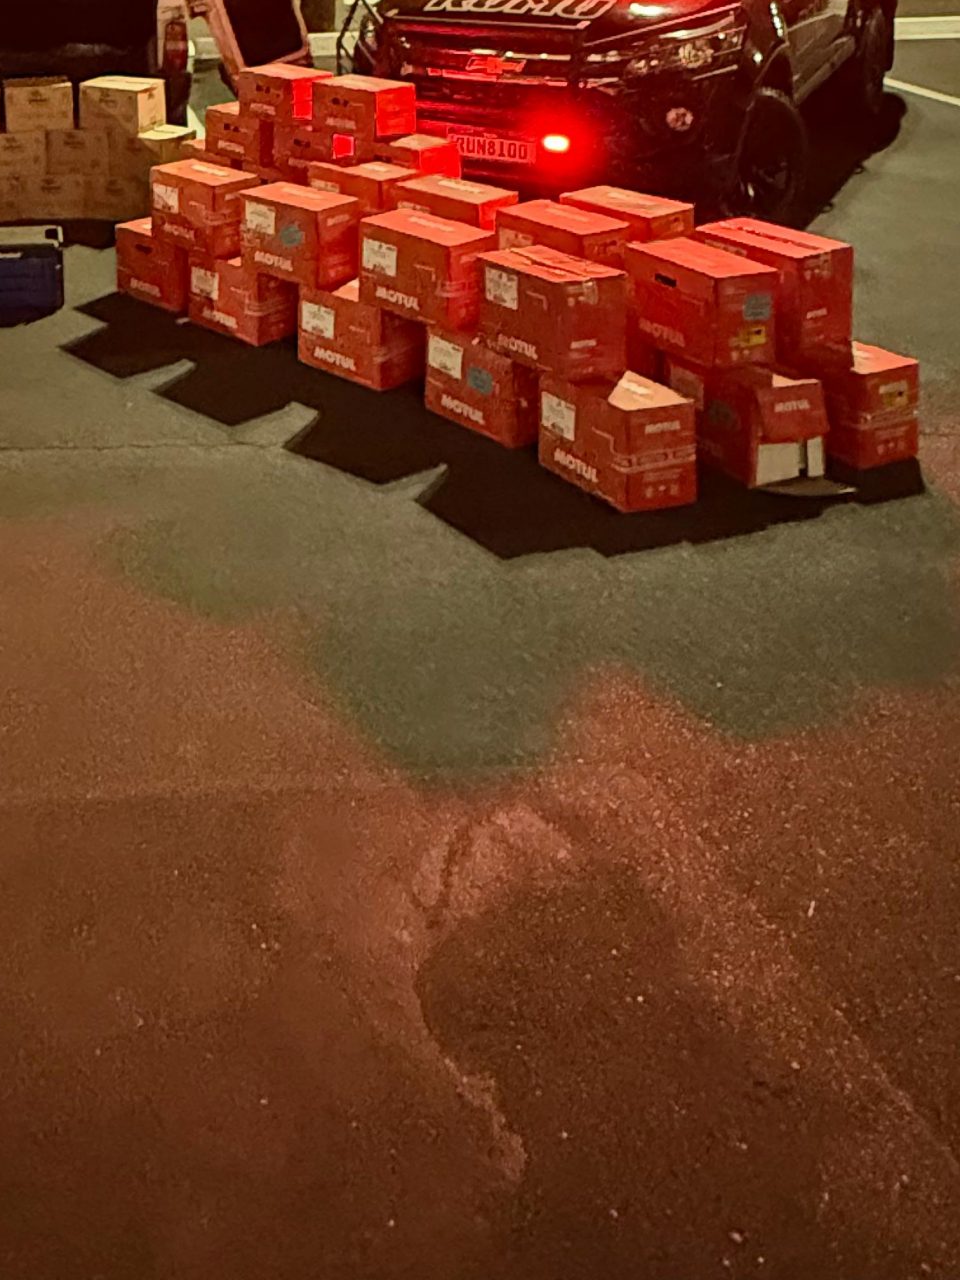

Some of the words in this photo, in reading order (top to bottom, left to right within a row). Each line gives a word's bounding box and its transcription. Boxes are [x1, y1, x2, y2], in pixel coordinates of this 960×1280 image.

[375, 286, 420, 311] MOTUL
[314, 346, 356, 371] MOTUL
[441, 394, 485, 425] MOTUL
[554, 448, 598, 484] MOTUL
